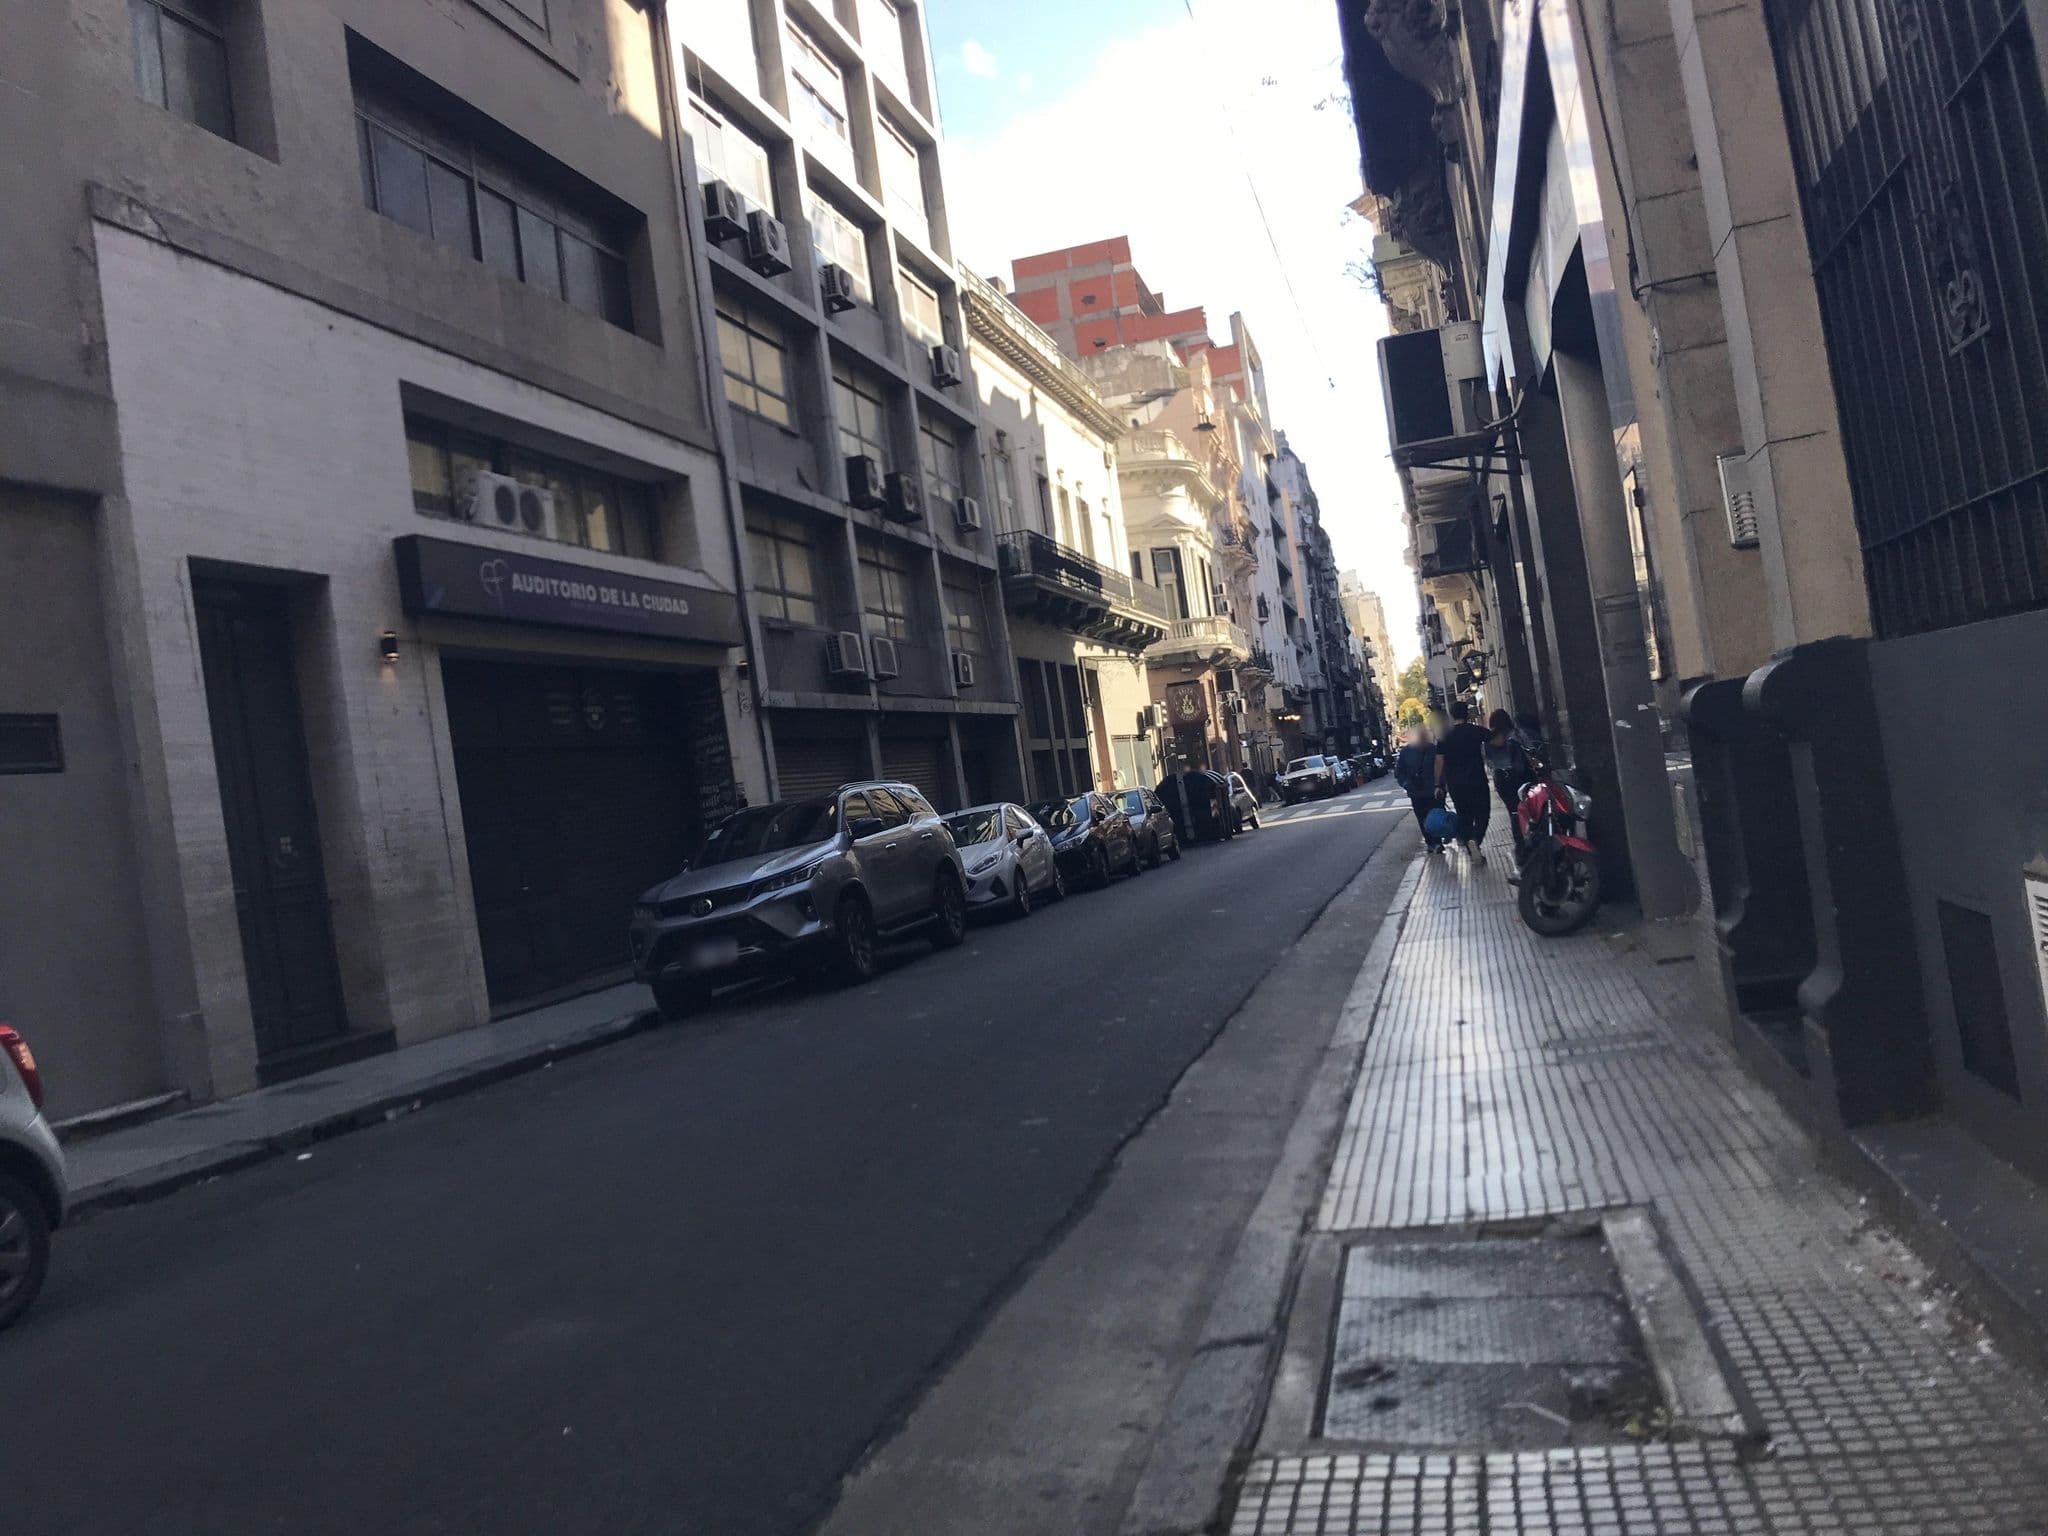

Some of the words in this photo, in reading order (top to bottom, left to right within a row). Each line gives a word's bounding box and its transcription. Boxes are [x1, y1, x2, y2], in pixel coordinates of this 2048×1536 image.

[511, 573, 598, 601] AUDITORIO
[600, 587, 619, 606] DE
[622, 592, 640, 608] LA
[642, 594, 689, 615] CIUDAD
